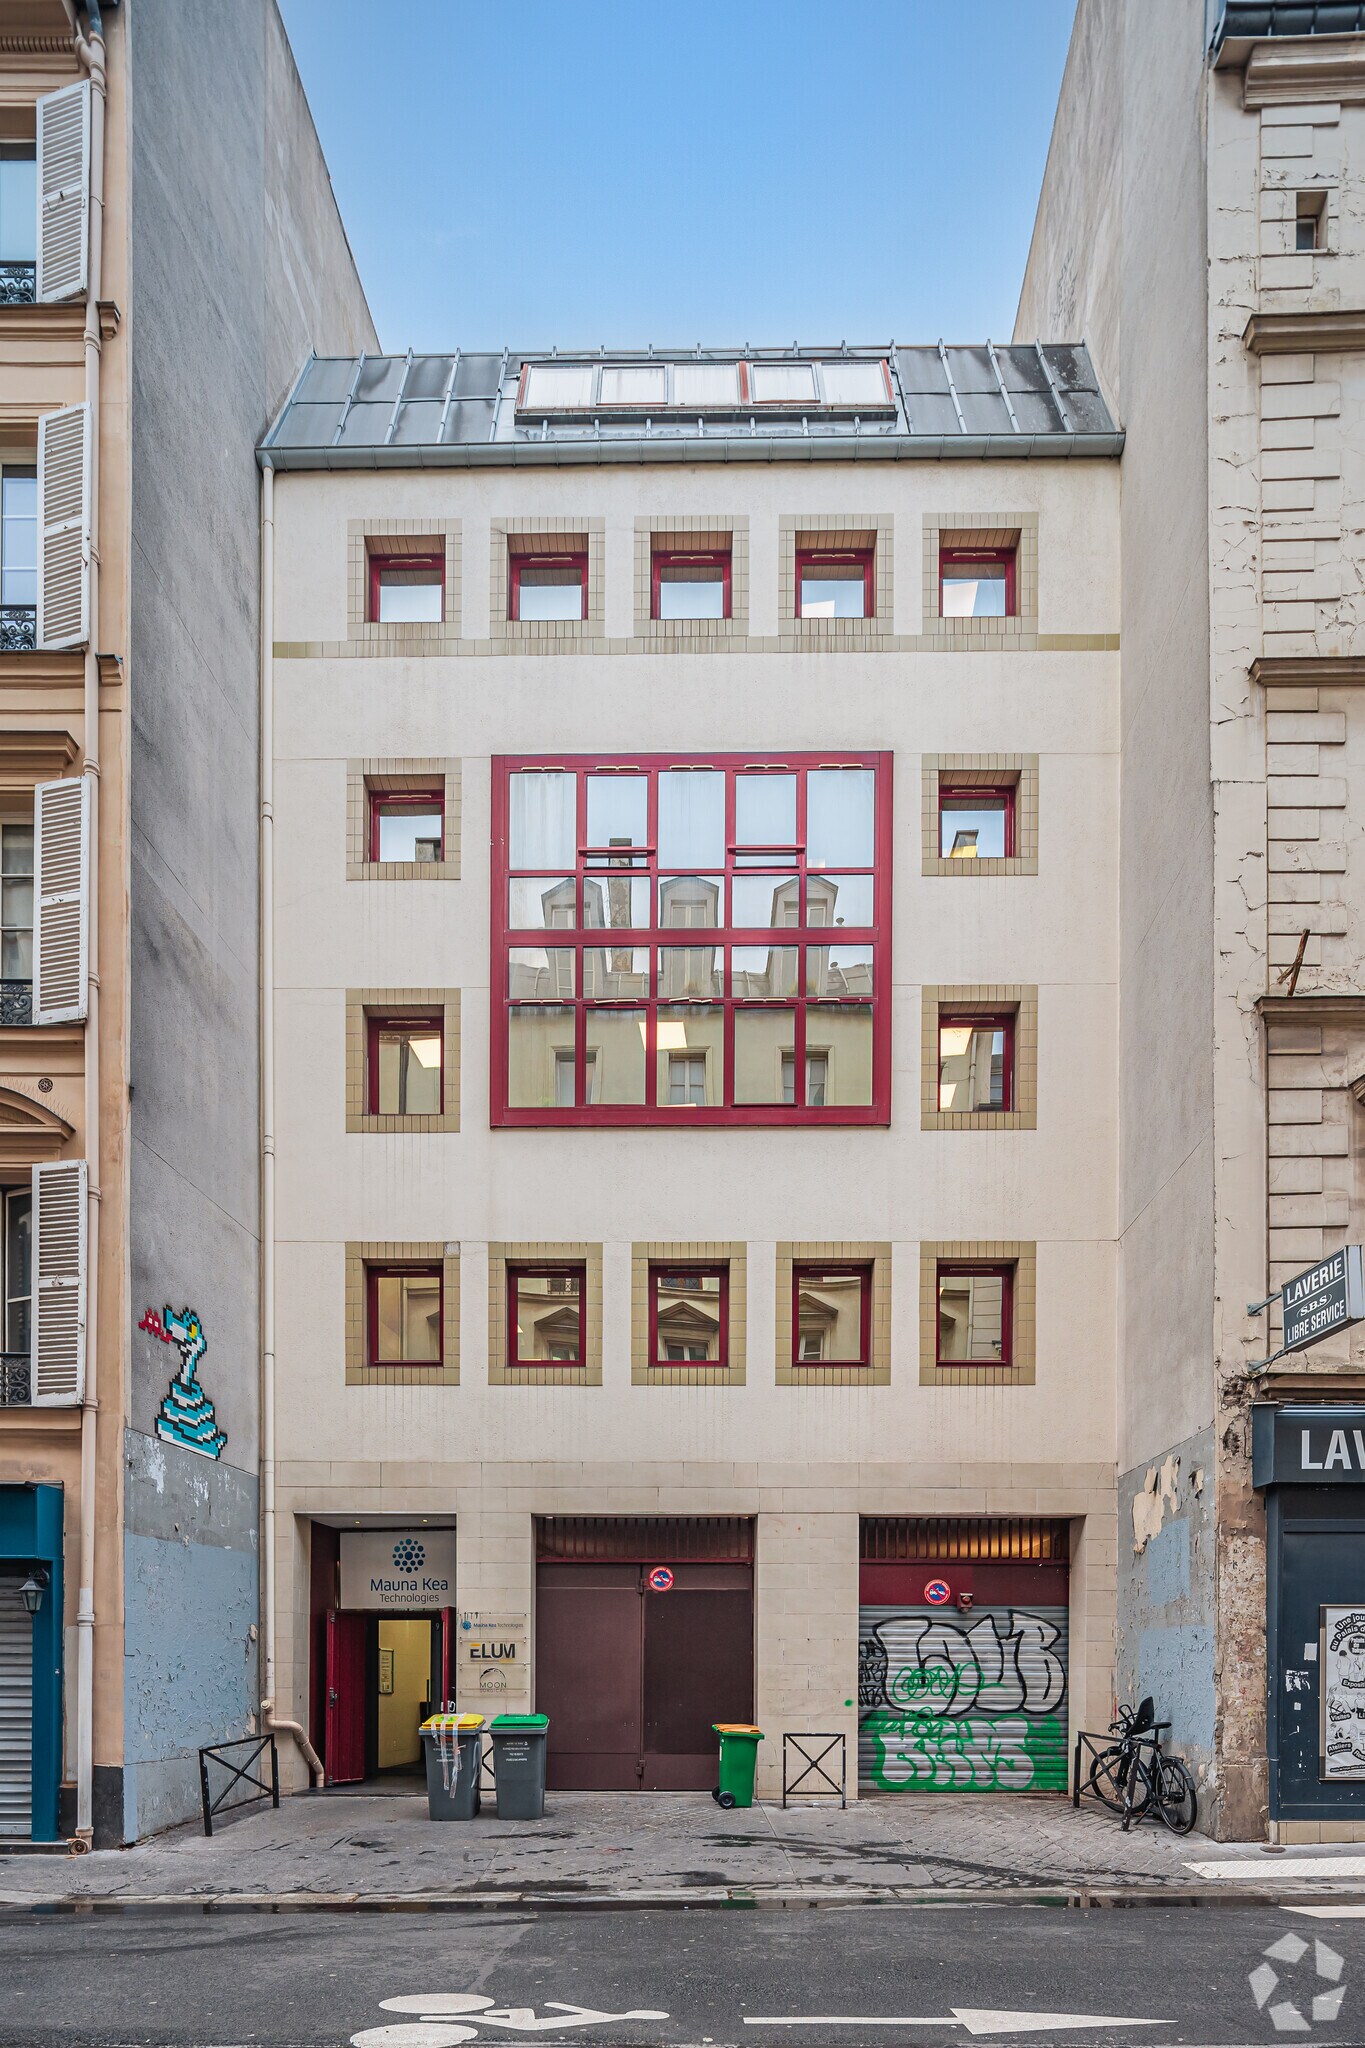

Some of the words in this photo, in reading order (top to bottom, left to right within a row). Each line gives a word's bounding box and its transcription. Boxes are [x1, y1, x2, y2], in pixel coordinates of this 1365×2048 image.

[1286, 1257, 1343, 1305] LAVERIE
[1287, 1318, 1310, 1344] LIBRE
[1310, 1299, 1345, 1332] SERVICE
[370, 1579, 418, 1591] Mauna
[422, 1578, 449, 1591] Kea
[379, 1593, 440, 1604] Technologies
[1336, 1617, 1352, 1630] Une
[1331, 1640, 1339, 1651] au
[479, 1681, 507, 1689] MOON
